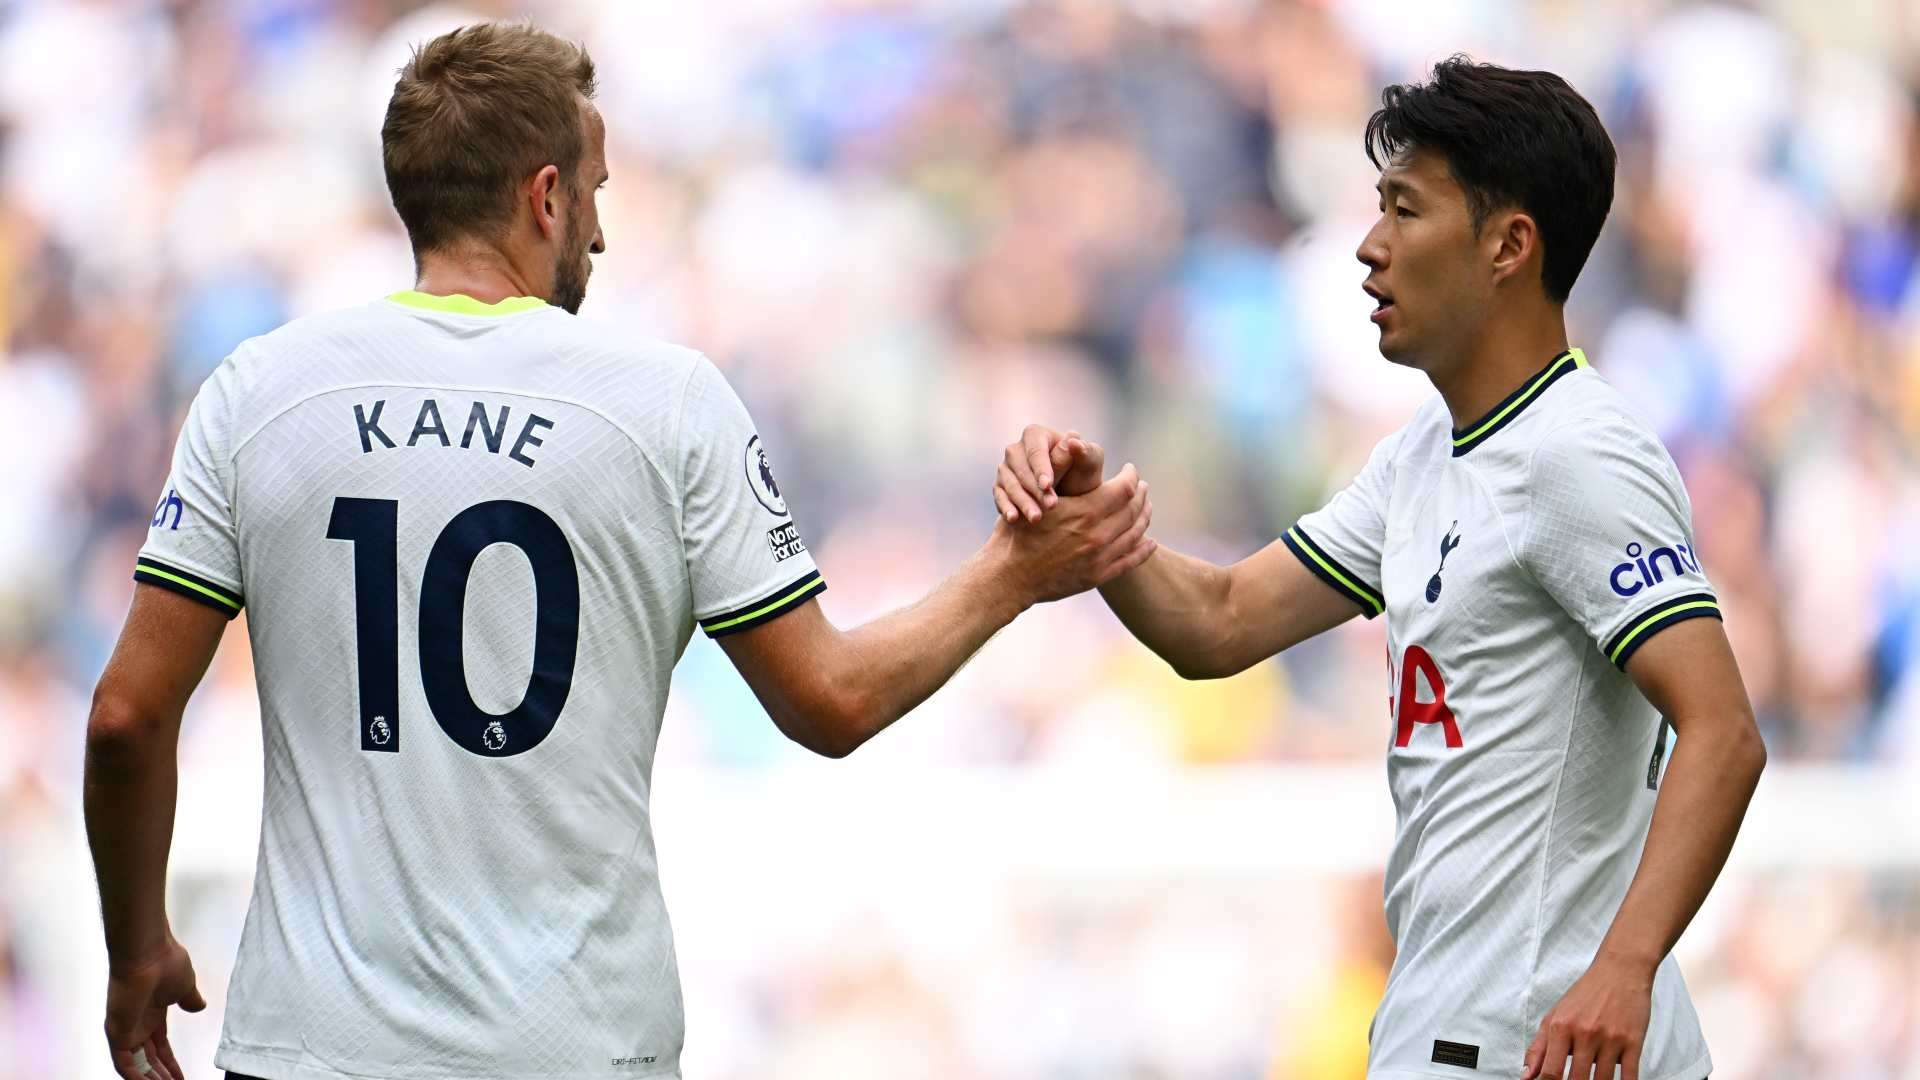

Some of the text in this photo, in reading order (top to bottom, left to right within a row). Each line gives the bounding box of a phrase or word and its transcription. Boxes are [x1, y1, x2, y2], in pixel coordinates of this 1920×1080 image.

[353, 399, 555, 469] KANE
[768, 529, 786, 546] No
[325, 496, 580, 758] 10
